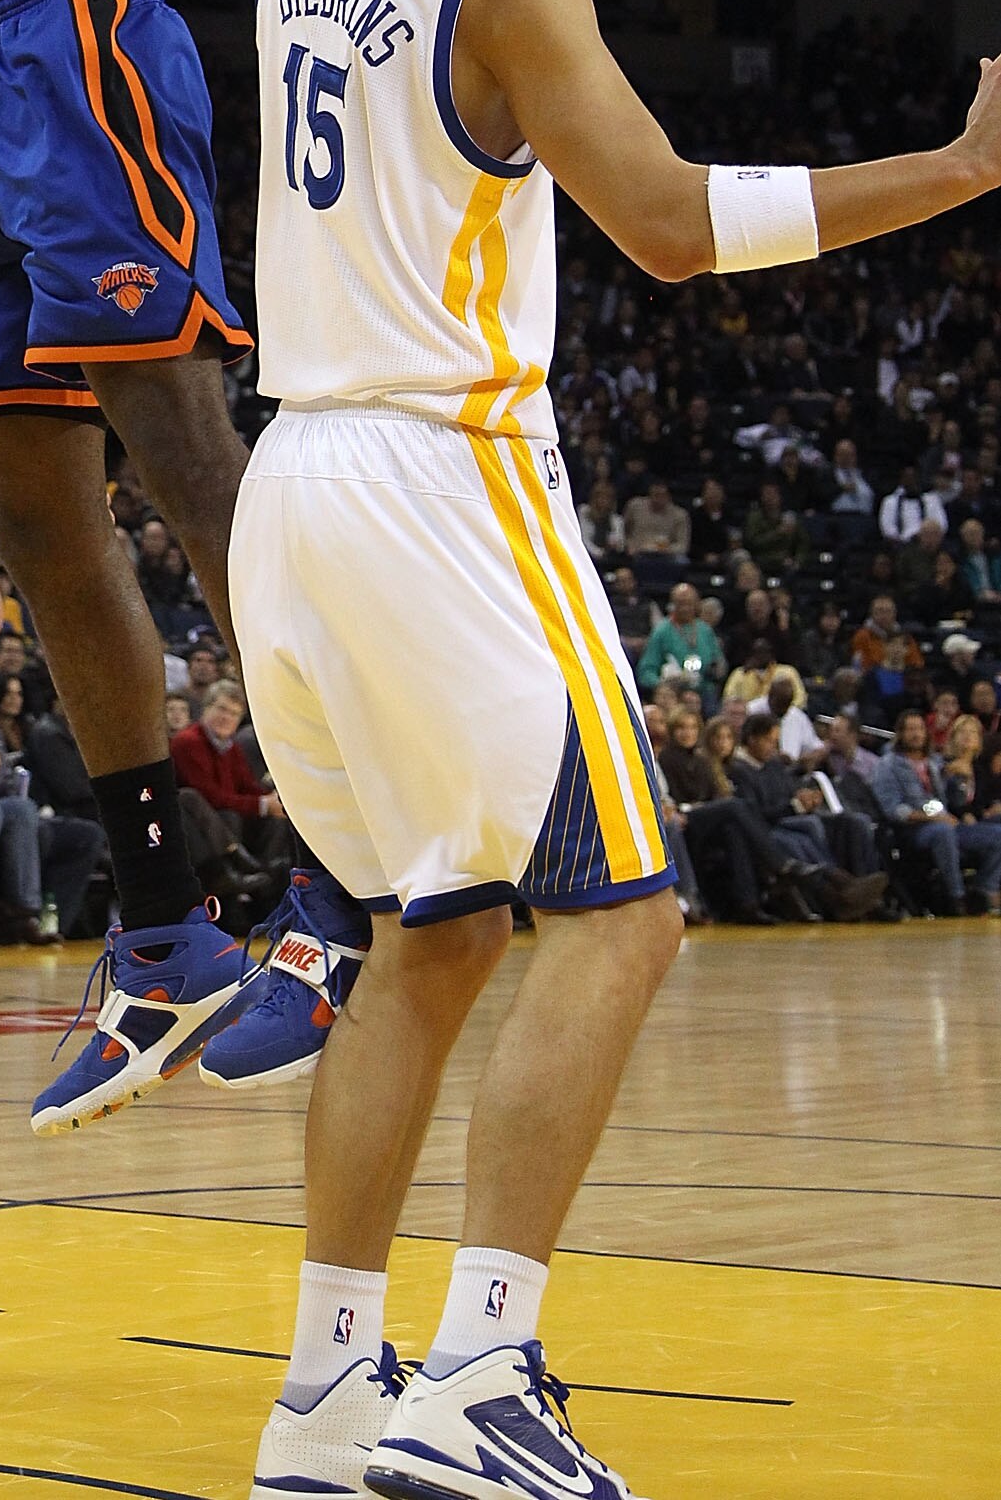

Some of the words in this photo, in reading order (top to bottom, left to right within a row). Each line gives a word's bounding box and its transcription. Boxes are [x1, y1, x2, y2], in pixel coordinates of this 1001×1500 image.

[282, 41, 352, 211] 15
[99, 264, 157, 295] KNICKS
[273, 937, 324, 973] NIKE
